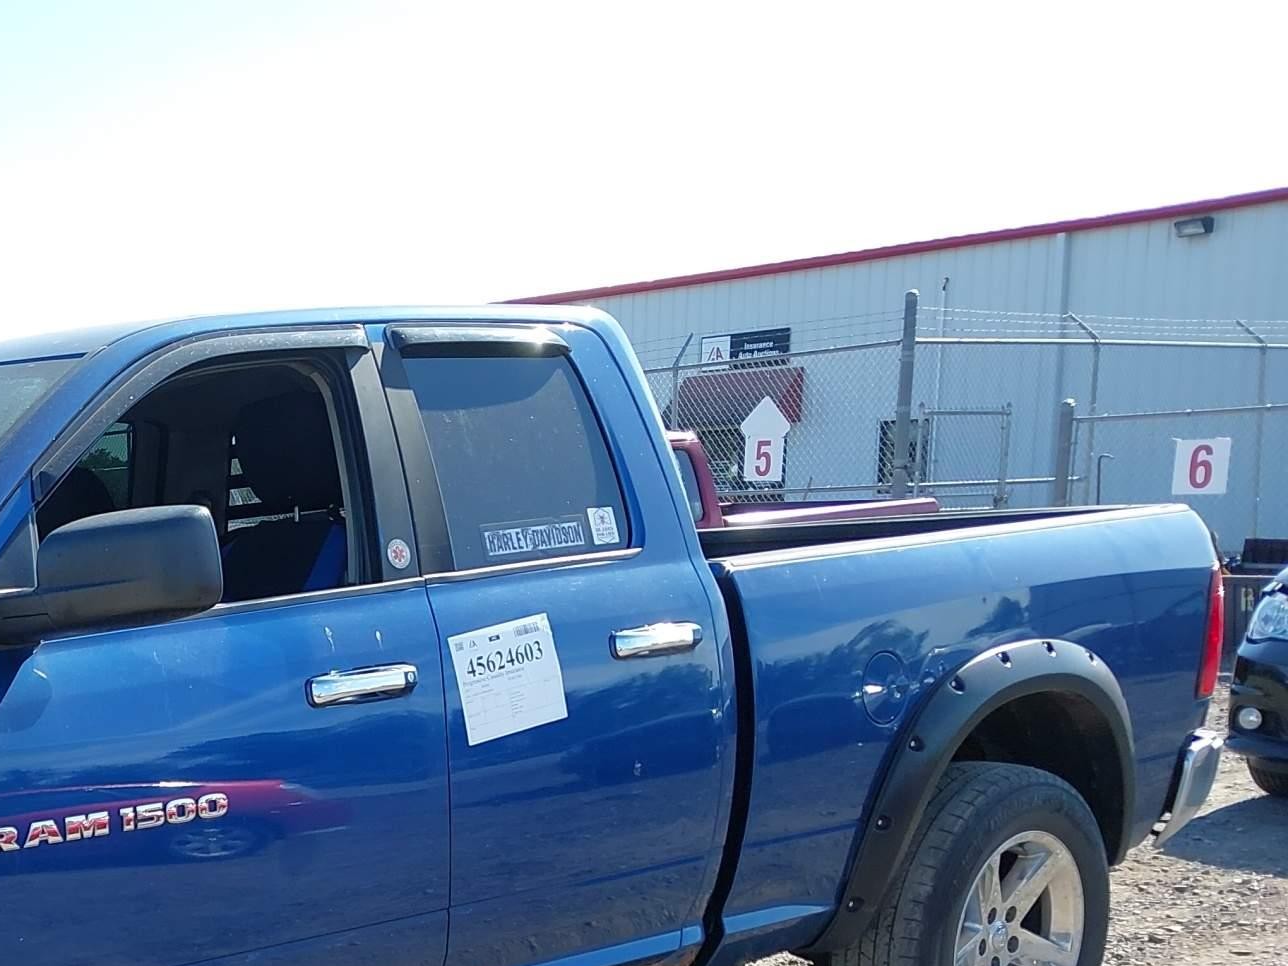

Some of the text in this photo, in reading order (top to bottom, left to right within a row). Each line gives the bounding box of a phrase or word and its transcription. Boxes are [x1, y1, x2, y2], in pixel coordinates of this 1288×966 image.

[744, 342, 774, 350] Insurance
[754, 440, 771, 477] 5
[1189, 444, 1213, 489] 6
[467, 640, 543, 677] 45624603
[119, 792, 229, 832] 1500
